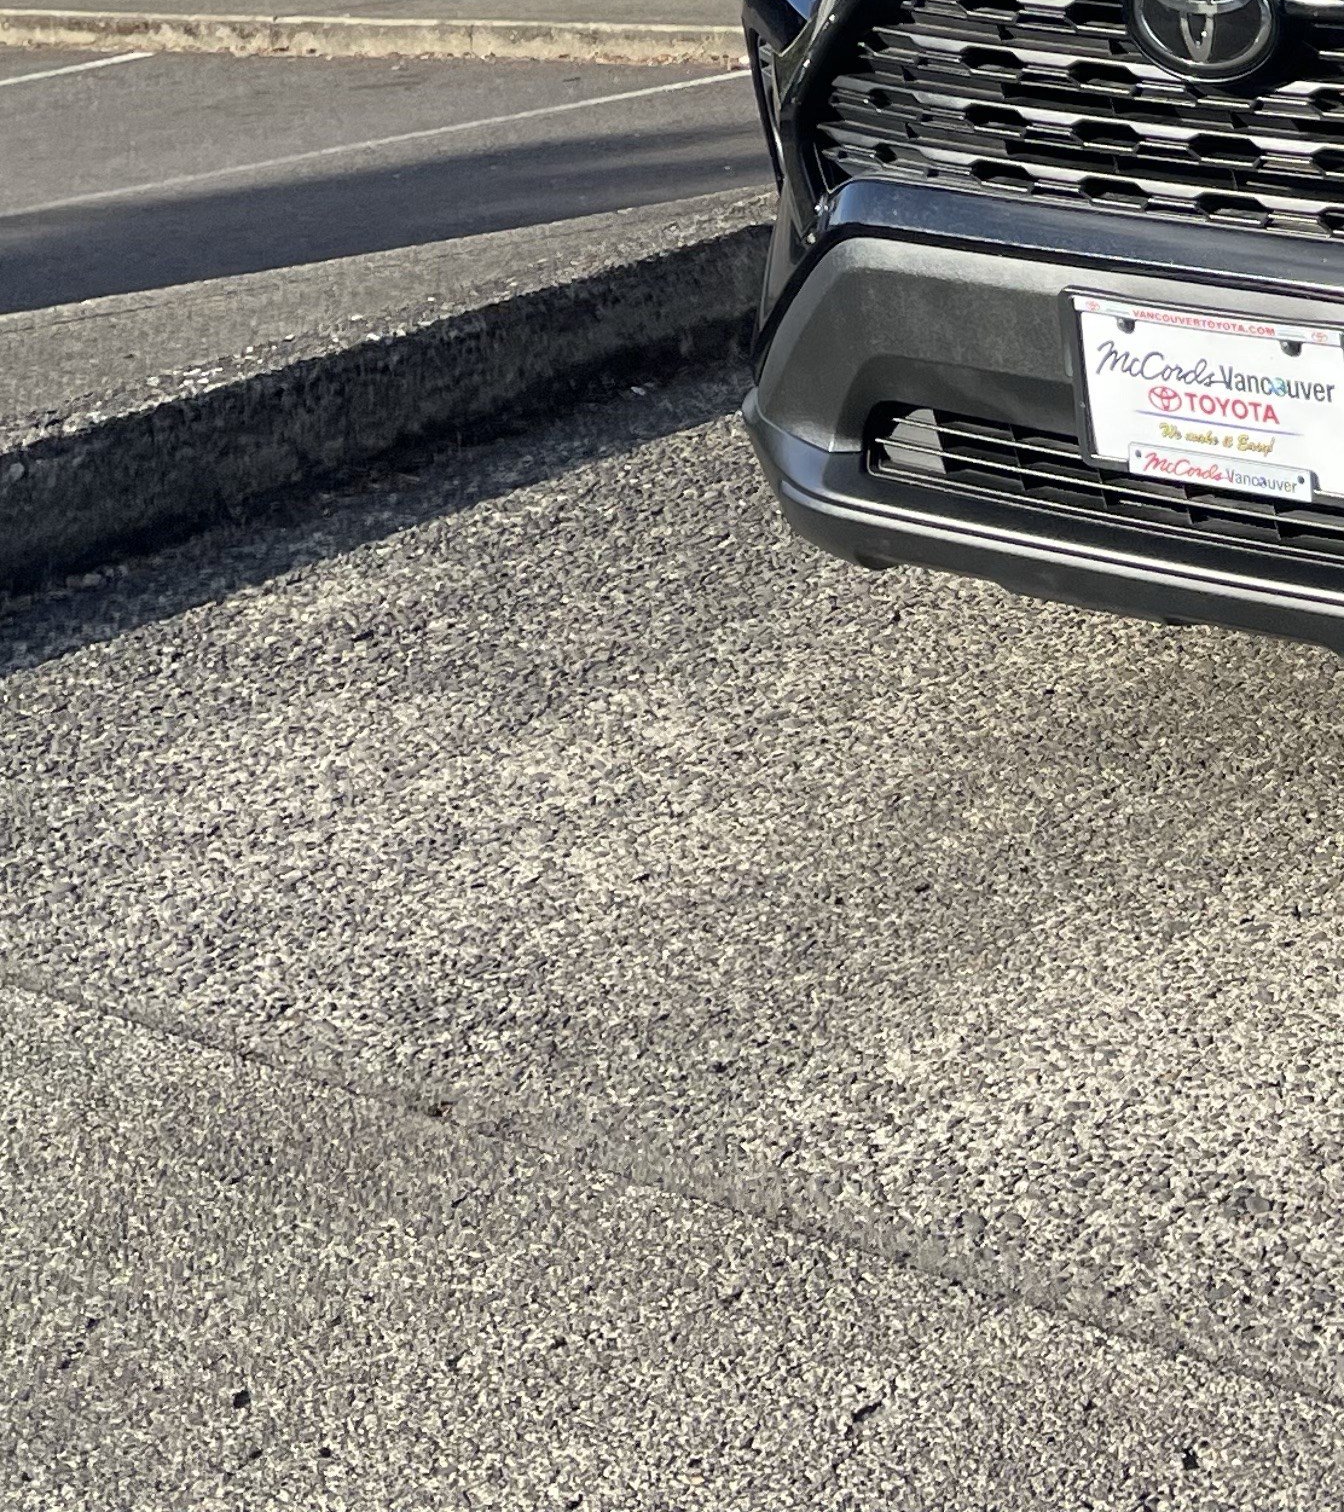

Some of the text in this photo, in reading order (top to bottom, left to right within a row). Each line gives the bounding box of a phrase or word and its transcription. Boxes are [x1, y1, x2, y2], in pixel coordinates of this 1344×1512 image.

[1132, 310, 1276, 336] VANCOUVERTOYOTA.COM
[1219, 365, 1336, 403] Vancouver
[1185, 392, 1280, 425] TOYOTA
[1225, 468, 1298, 494] Vancouver
